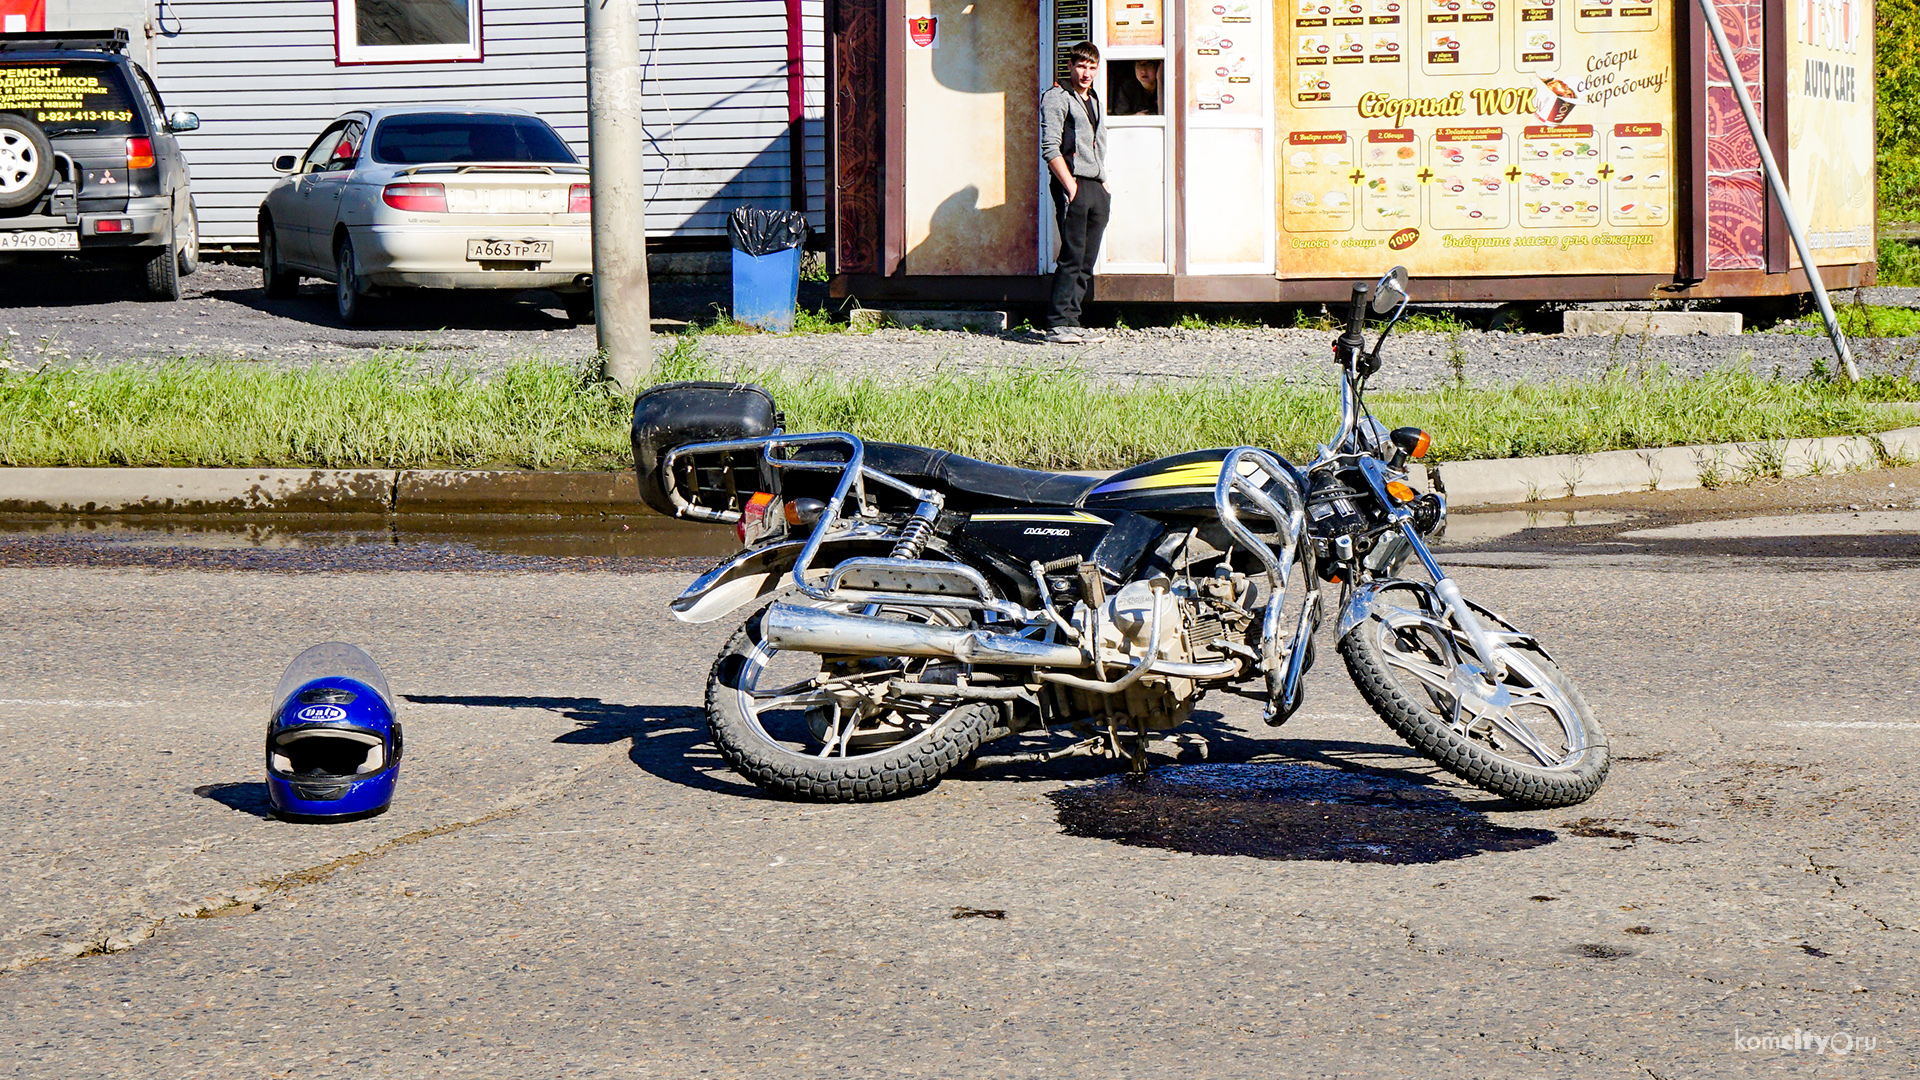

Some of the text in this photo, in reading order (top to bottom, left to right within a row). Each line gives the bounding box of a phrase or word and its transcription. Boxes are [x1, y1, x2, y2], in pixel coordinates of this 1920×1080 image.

[1586, 48, 1639, 72] Собери
[0, 68, 60, 78] РЕМОНТ
[1577, 72, 1615, 92] свою
[1804, 59, 1855, 103] AUTO CAFE
[1587, 66, 1669, 108] коробочку!
[38, 111, 133, 122] 8-924-413-16-37
[1358, 87, 1538, 128] Сборный WOK
[60, 233, 72, 243] 27
[534, 243, 547, 253] 27
[1291, 238, 1329, 248] Основа
[1341, 237, 1376, 249] овощи
[1442, 232, 1654, 252] Выберите масло для обжарки
